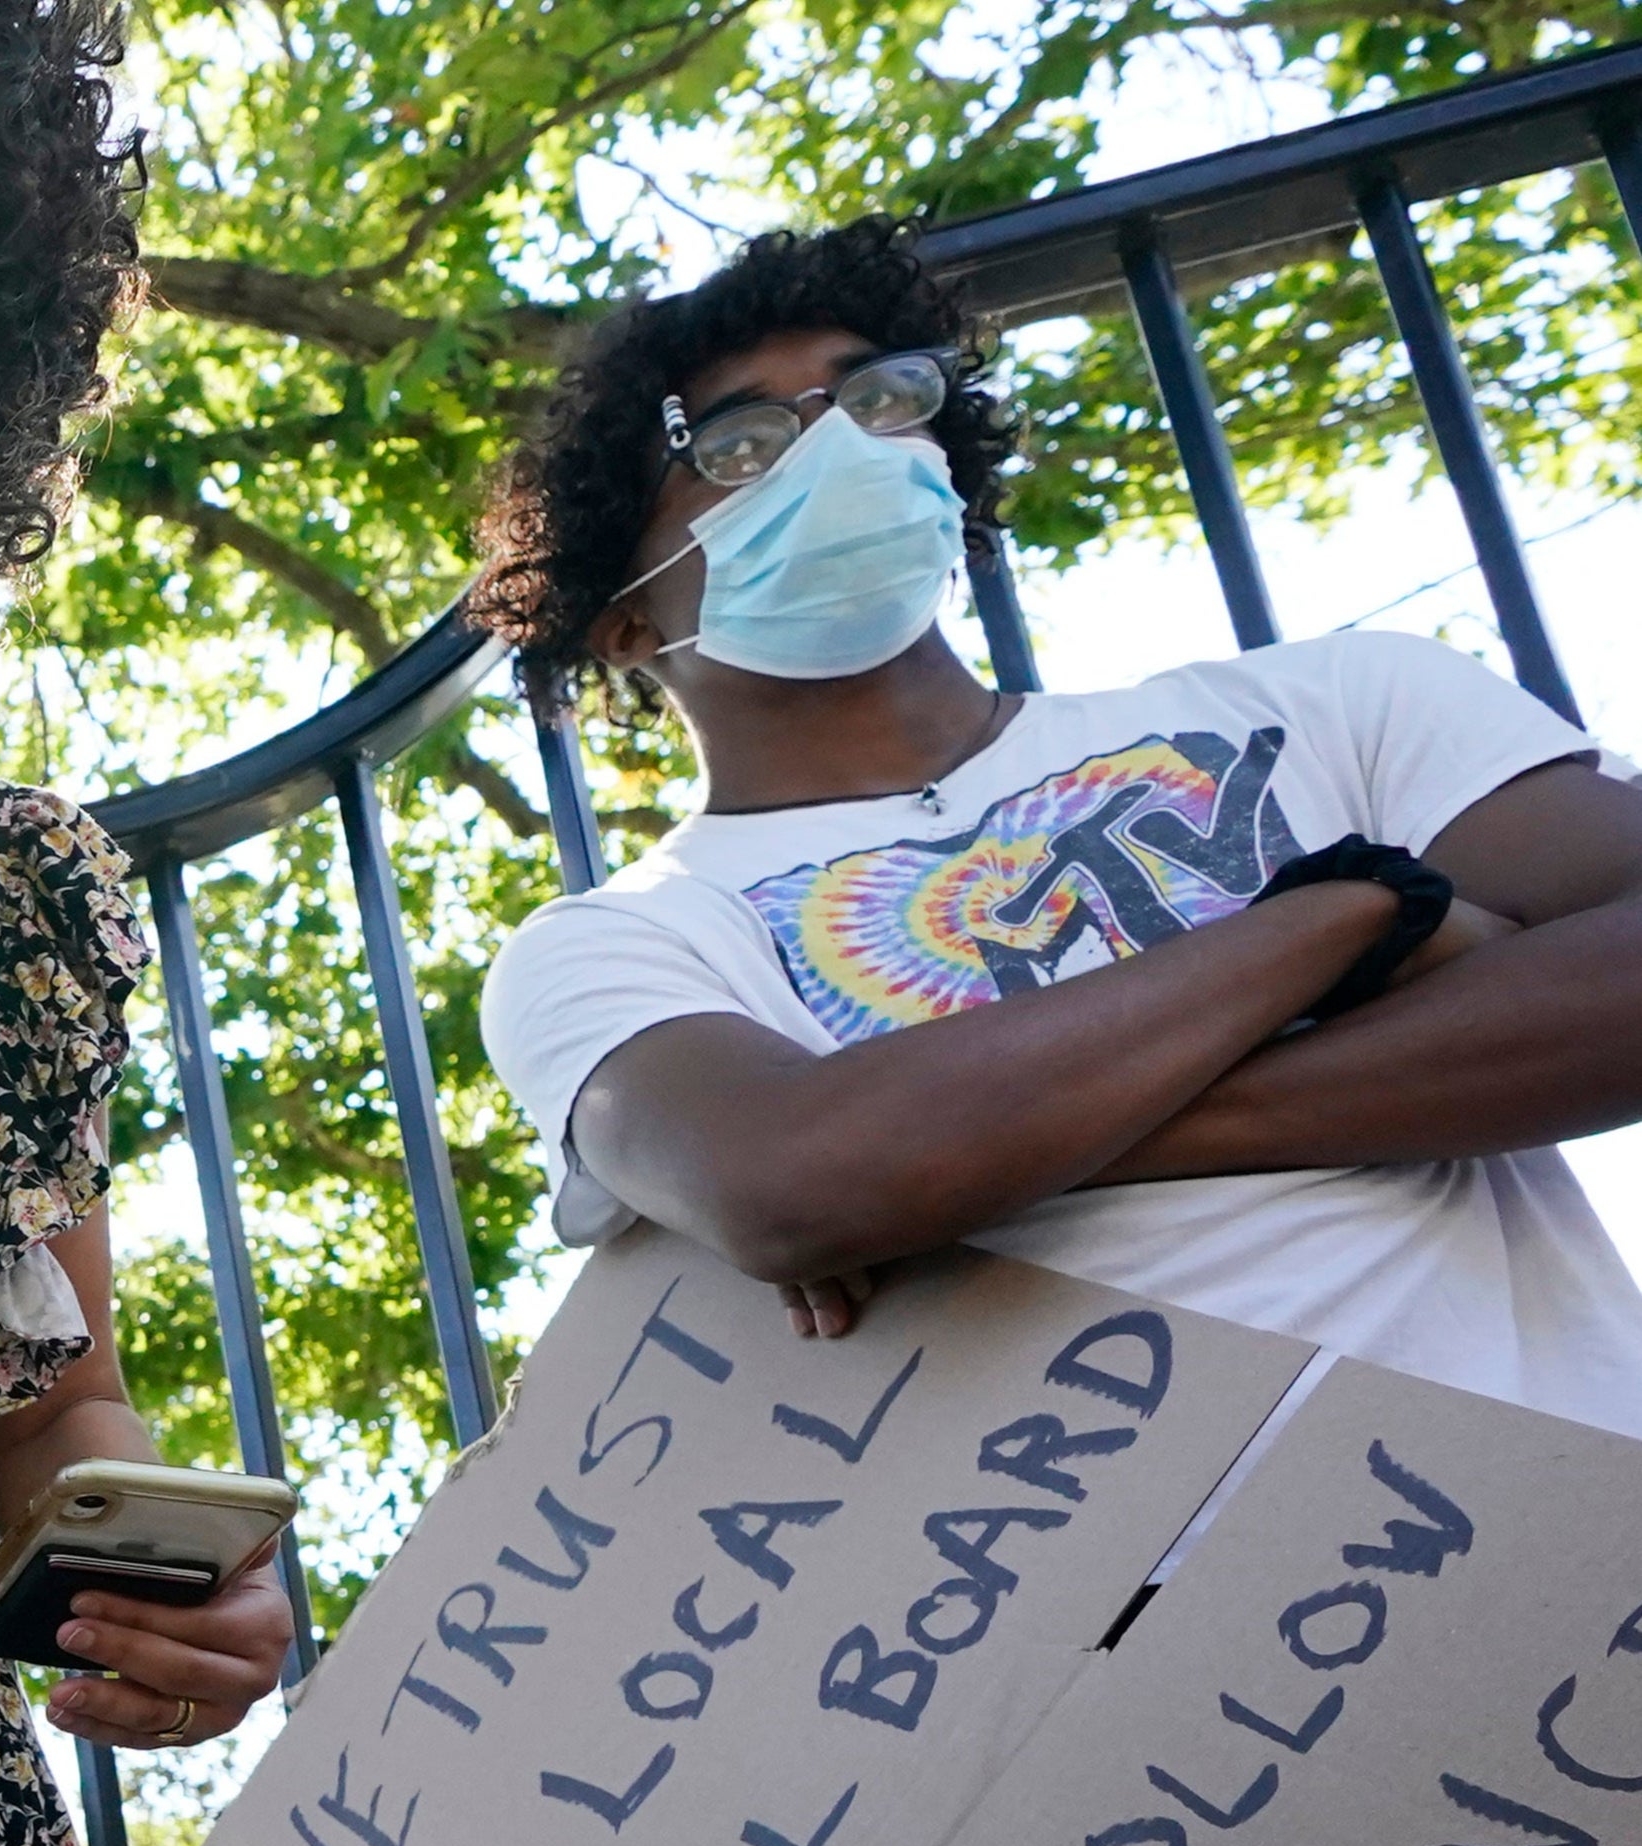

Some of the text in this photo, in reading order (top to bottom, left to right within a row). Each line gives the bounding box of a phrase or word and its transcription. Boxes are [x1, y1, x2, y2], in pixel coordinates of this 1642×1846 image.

[383, 1276, 732, 1733] TRUST
[540, 1346, 923, 1834] LOCAL
[820, 1310, 1172, 1732] BOARD
